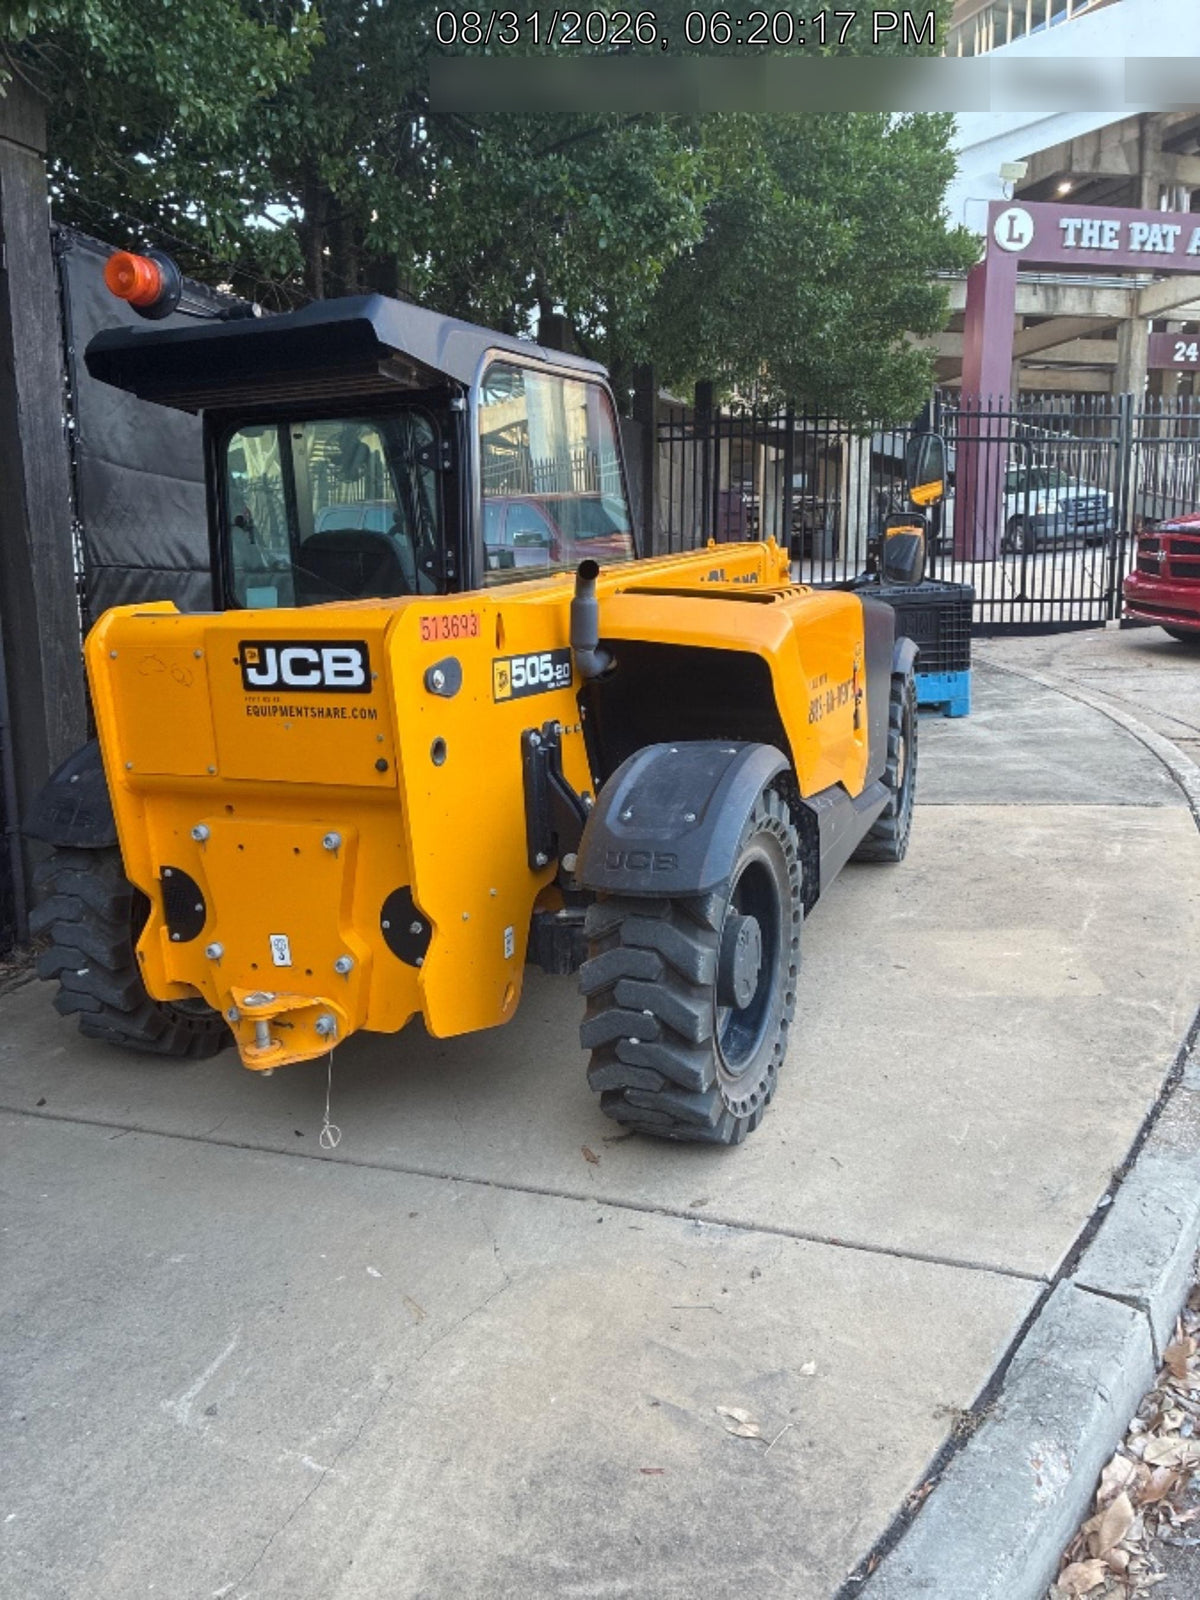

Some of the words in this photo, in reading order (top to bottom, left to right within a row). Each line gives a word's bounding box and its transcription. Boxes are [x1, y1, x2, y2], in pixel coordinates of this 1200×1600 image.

[1006, 215, 1023, 243] L
[1059, 218, 1120, 249] THE
[1129, 222, 1181, 252] PAT
[1174, 341, 1199, 362] 24
[421, 614, 478, 641] 513693
[246, 648, 366, 685] JCB
[246, 705, 378, 720] EQUIPMENTSHARE.COM
[605, 851, 679, 872] JCB
